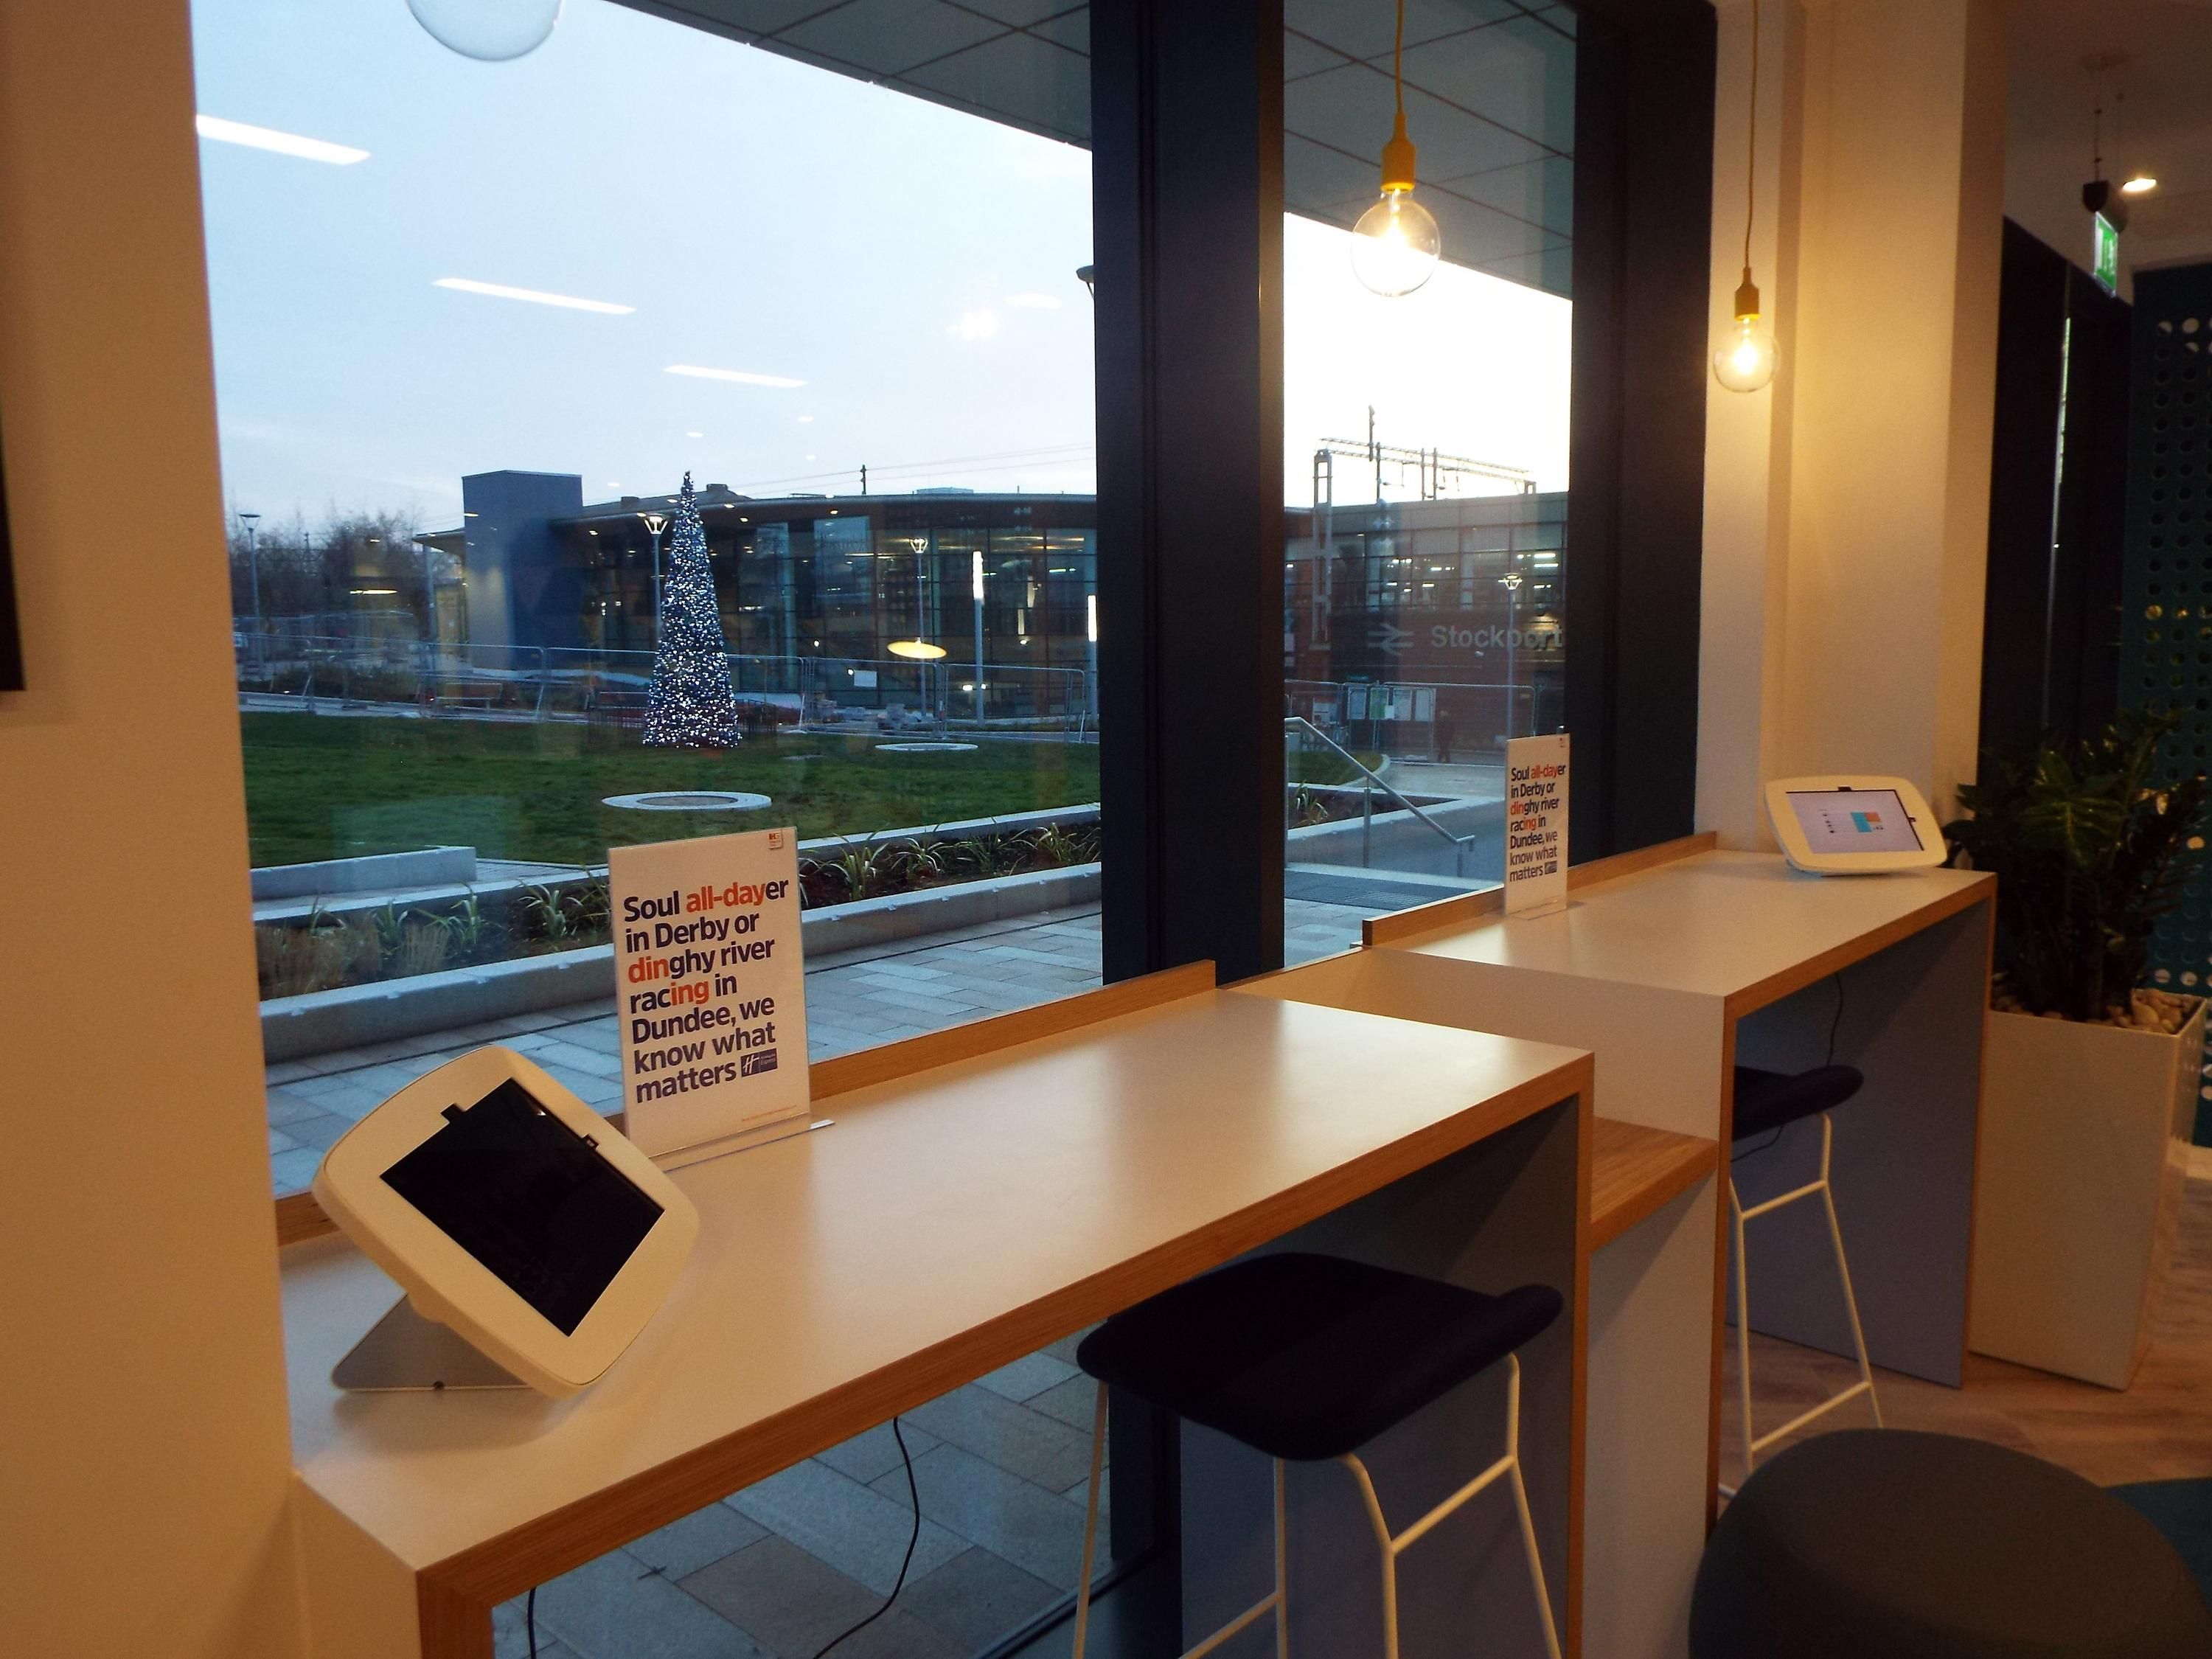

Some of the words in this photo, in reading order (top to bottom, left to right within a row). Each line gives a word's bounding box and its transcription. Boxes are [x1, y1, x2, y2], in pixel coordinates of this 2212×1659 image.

[1431, 625, 1563, 648] Stockport
[1512, 766, 1529, 782] Soul
[1531, 763, 1565, 779] all-dayer
[1511, 785, 1519, 799] in
[1520, 782, 1546, 798] Derby
[1547, 782, 1555, 793] or
[1510, 800, 1539, 815] dinghy
[1541, 796, 1559, 810] river
[1510, 818, 1537, 832] racing
[1538, 815, 1546, 827] in
[1510, 832, 1545, 849] Dundee,
[1546, 830, 1557, 842] we
[1510, 850, 1534, 866] know
[1536, 846, 1557, 861] what
[1510, 864, 1543, 883] matters
[624, 890, 679, 922] Soul
[686, 878, 789, 913] all-dayer
[627, 928, 649, 953] in
[656, 915, 730, 949] Derby
[734, 911, 759, 934] or
[628, 949, 715, 984] dinghy
[721, 938, 774, 966] river
[630, 979, 709, 1014] racing
[715, 973, 737, 997] in
[632, 1007, 736, 1044] Dundee,
[739, 995, 774, 1020] we
[634, 1040, 706, 1074] know
[713, 1021, 776, 1056] what
[636, 1061, 737, 1103] matters
